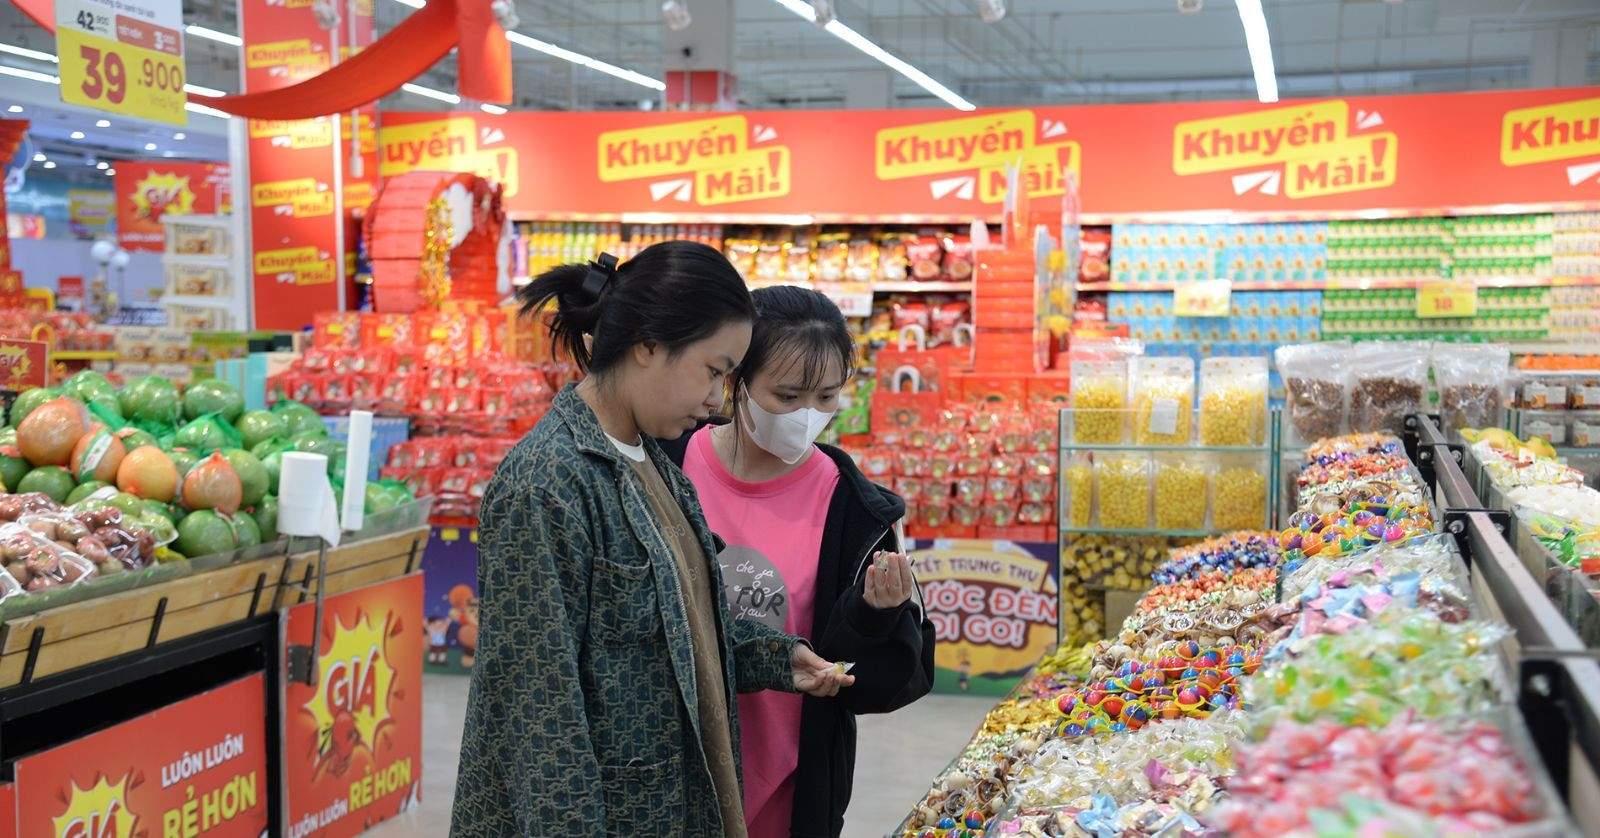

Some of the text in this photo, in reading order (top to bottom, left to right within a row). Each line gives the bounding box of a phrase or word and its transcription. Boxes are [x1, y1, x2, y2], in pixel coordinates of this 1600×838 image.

[77, 10, 95, 31] 42
[80, 44, 182, 105] 39 .900
[606, 125, 737, 168] Khuyến
[884, 120, 1024, 166] Khuyến
[1182, 111, 1336, 161] Khuyến
[706, 151, 782, 199] Mãi!
[1297, 138, 1388, 191] Mãi!
[948, 557, 1001, 574] TRUNG
[1008, 562, 1041, 582] THU
[736, 586, 785, 617] FOR
[966, 614, 1023, 645] GO!
[326, 644, 380, 718] GIÁ
[161, 733, 245, 789] LUÔN LUÔN
[162, 770, 257, 838] RẺ HƠN
[319, 798, 348, 829] LUÔN
[348, 765, 373, 813] RẺ
[374, 757, 412, 801] HƠN
